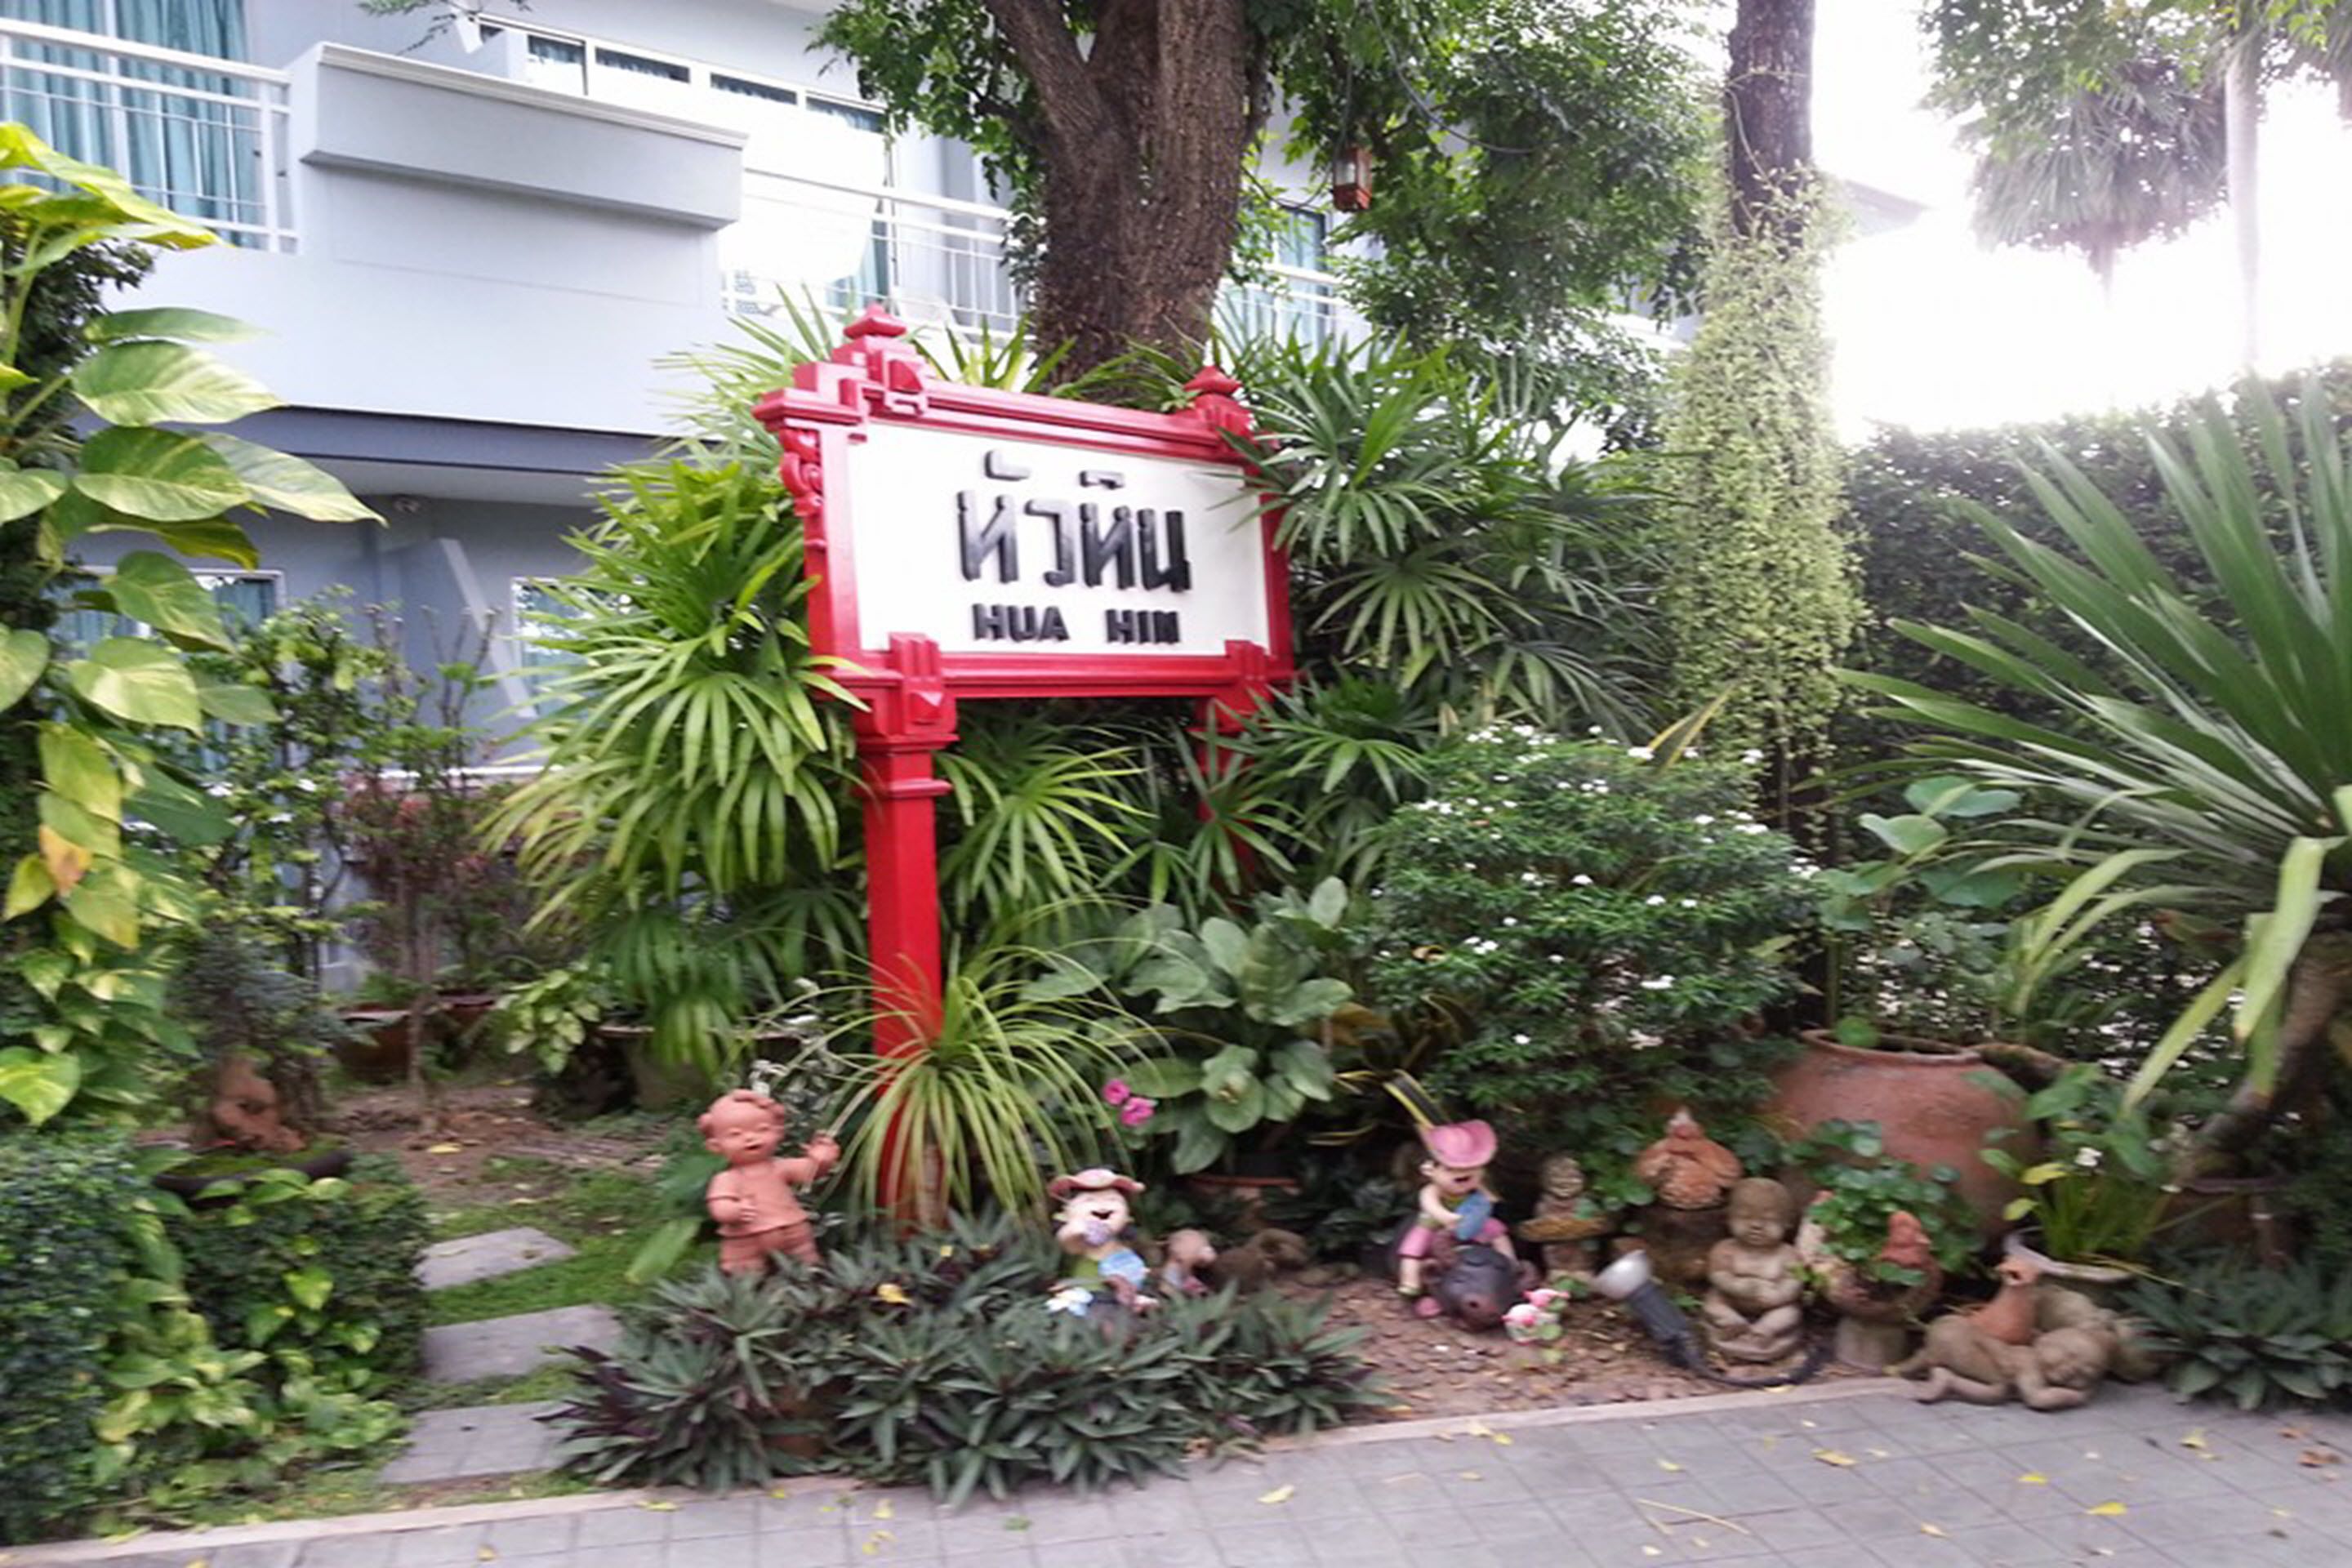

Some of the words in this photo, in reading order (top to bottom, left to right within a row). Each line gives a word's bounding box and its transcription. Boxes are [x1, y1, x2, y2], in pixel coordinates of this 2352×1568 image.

[956, 449, 1192, 593] หัวหิน
[972, 604, 1070, 642] HUA
[1104, 608, 1181, 644] HIN
